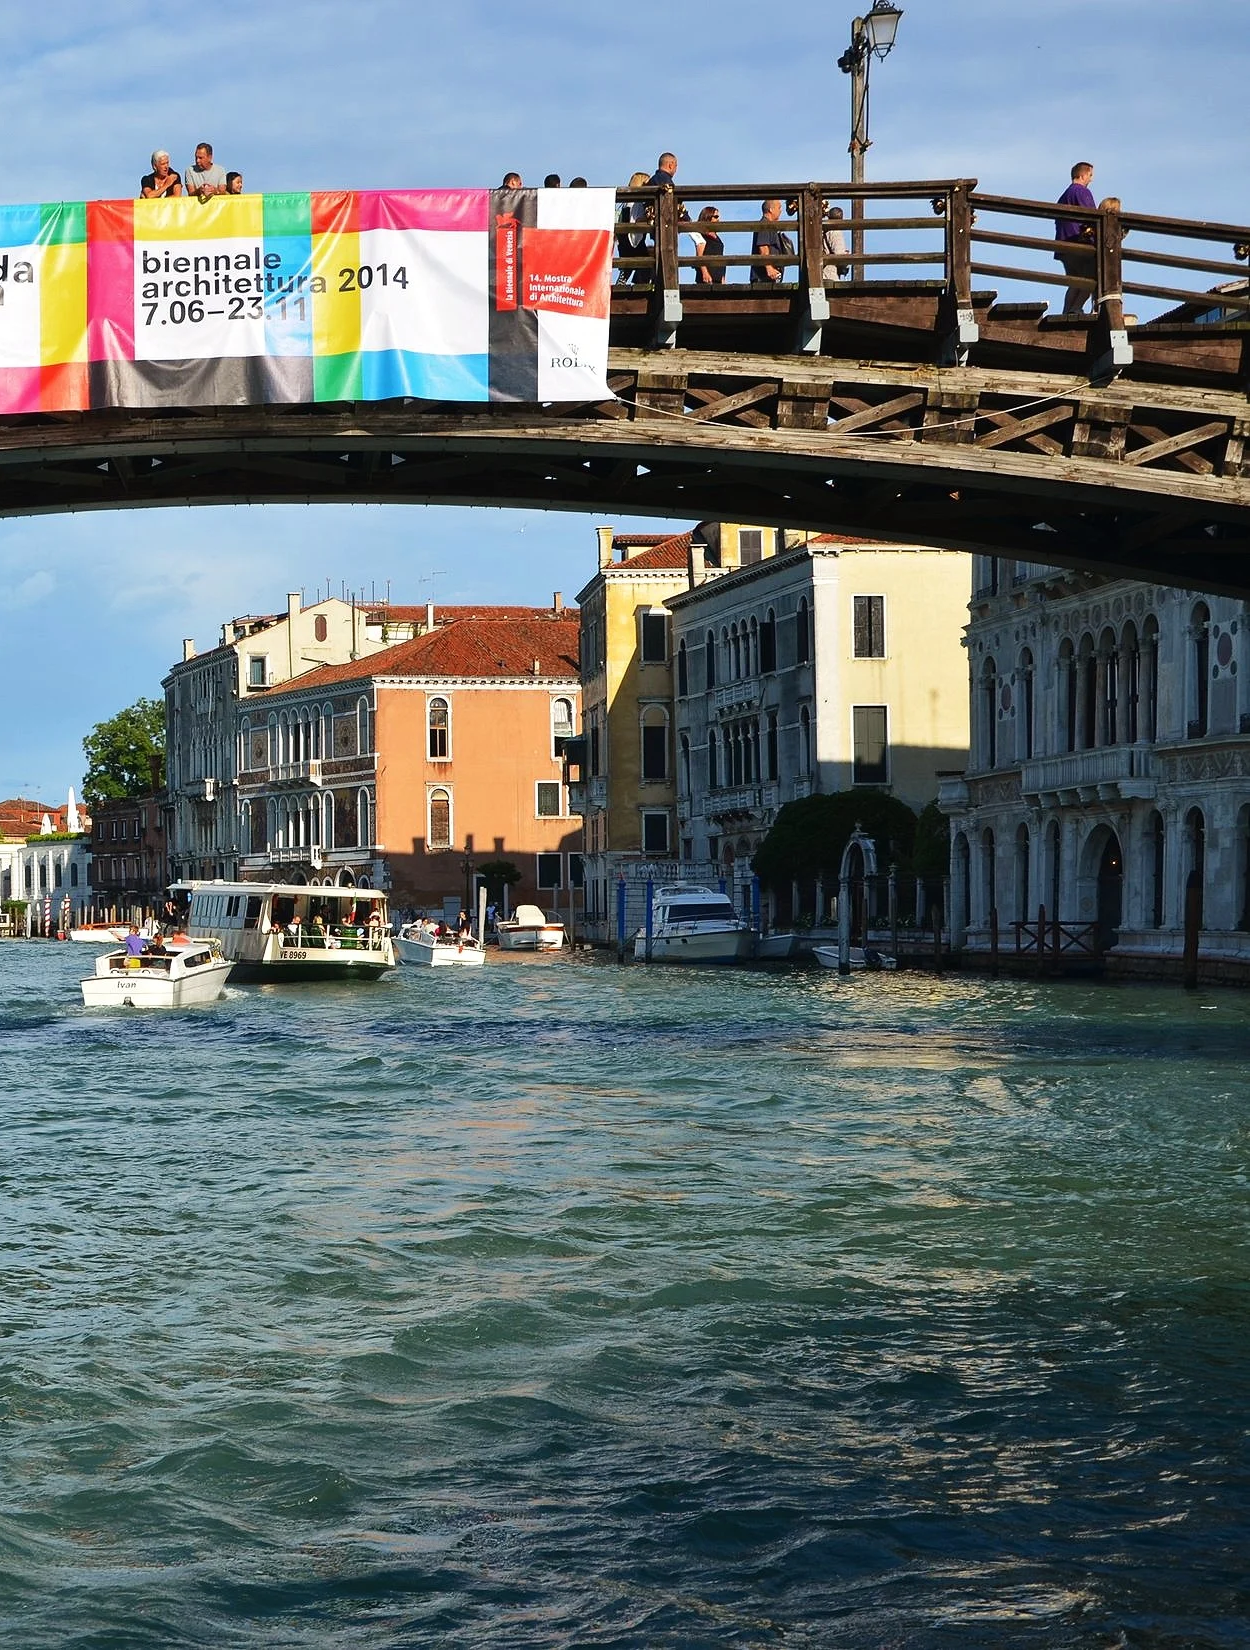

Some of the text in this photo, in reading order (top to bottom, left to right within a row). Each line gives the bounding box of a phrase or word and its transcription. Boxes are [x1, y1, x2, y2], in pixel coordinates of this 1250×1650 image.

[142, 247, 282, 275] biennale
[141, 263, 409, 299] architettura 2014
[529, 274, 572, 283] 14. Mostra
[530, 283, 585, 296] Internazionale
[540, 293, 584, 307] Architettura
[289, 951, 307, 960] 8969
